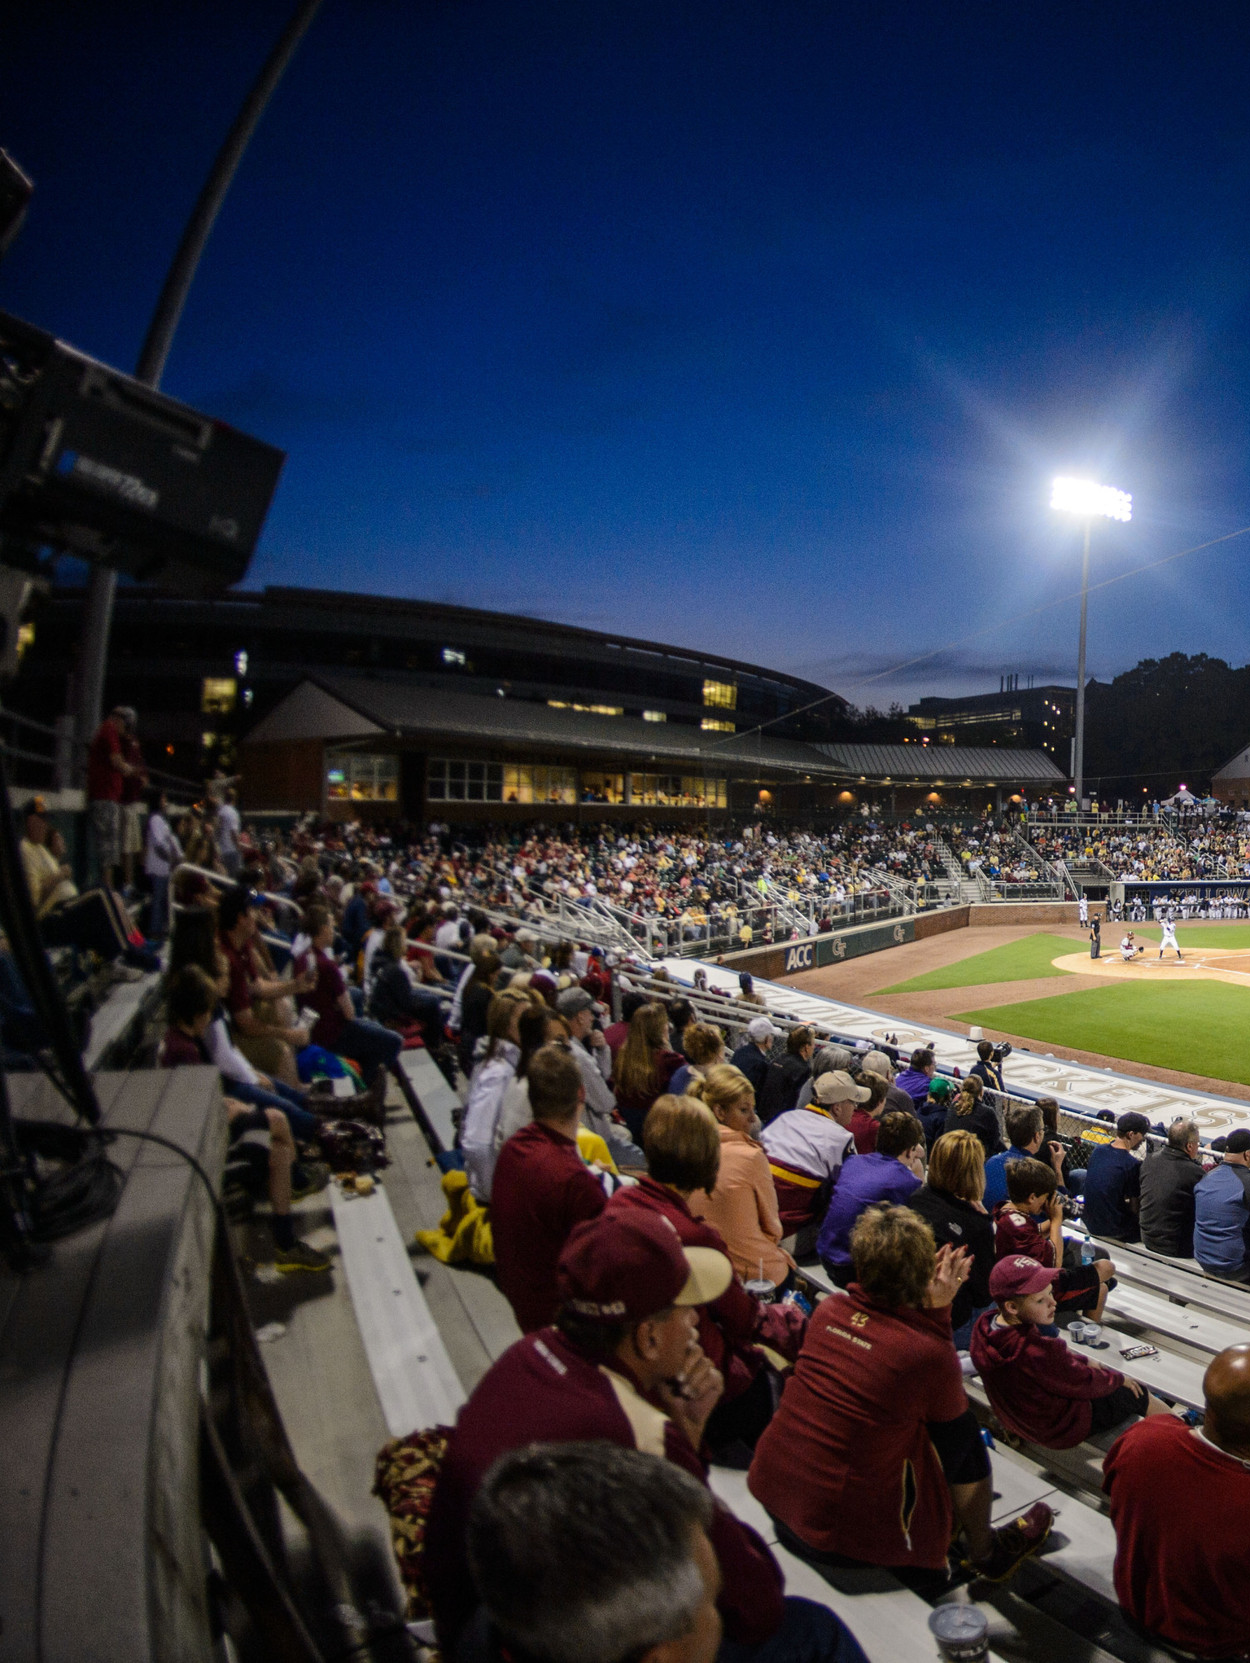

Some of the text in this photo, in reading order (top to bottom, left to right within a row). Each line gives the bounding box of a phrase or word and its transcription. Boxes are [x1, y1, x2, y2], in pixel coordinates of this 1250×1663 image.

[786, 943, 813, 971] ACC
[851, 1311, 870, 1327] 43
[826, 1325, 873, 1351] FLORIDA STATE
